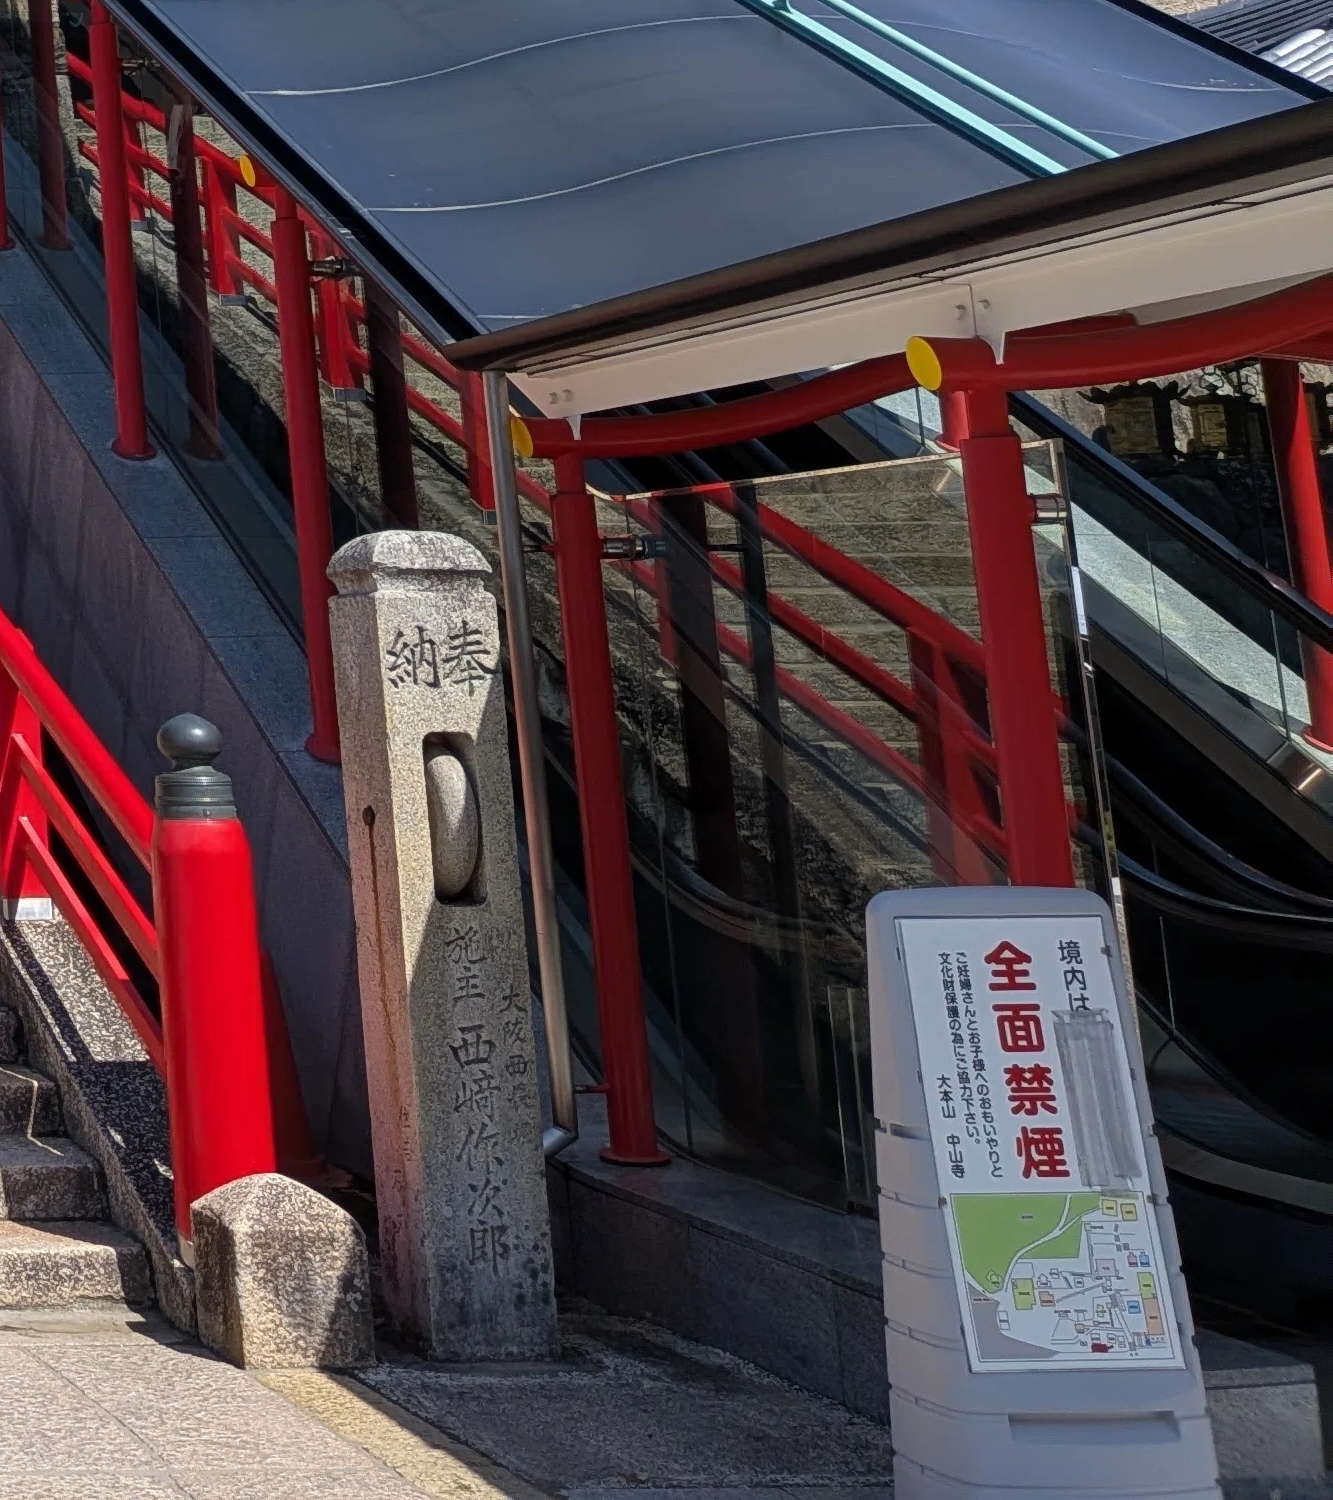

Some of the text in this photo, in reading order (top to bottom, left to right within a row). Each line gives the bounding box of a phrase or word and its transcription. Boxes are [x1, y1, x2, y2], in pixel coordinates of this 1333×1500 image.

[386, 619, 501, 697] 奉納
[1057, 940, 1090, 1011] 境内は
[956, 952, 1003, 1178] ご妊婦さんとお子様へのおもいやりと
[984, 940, 1071, 1180] 全面禁煙
[936, 1074, 965, 1179] 大本山 中山寺
